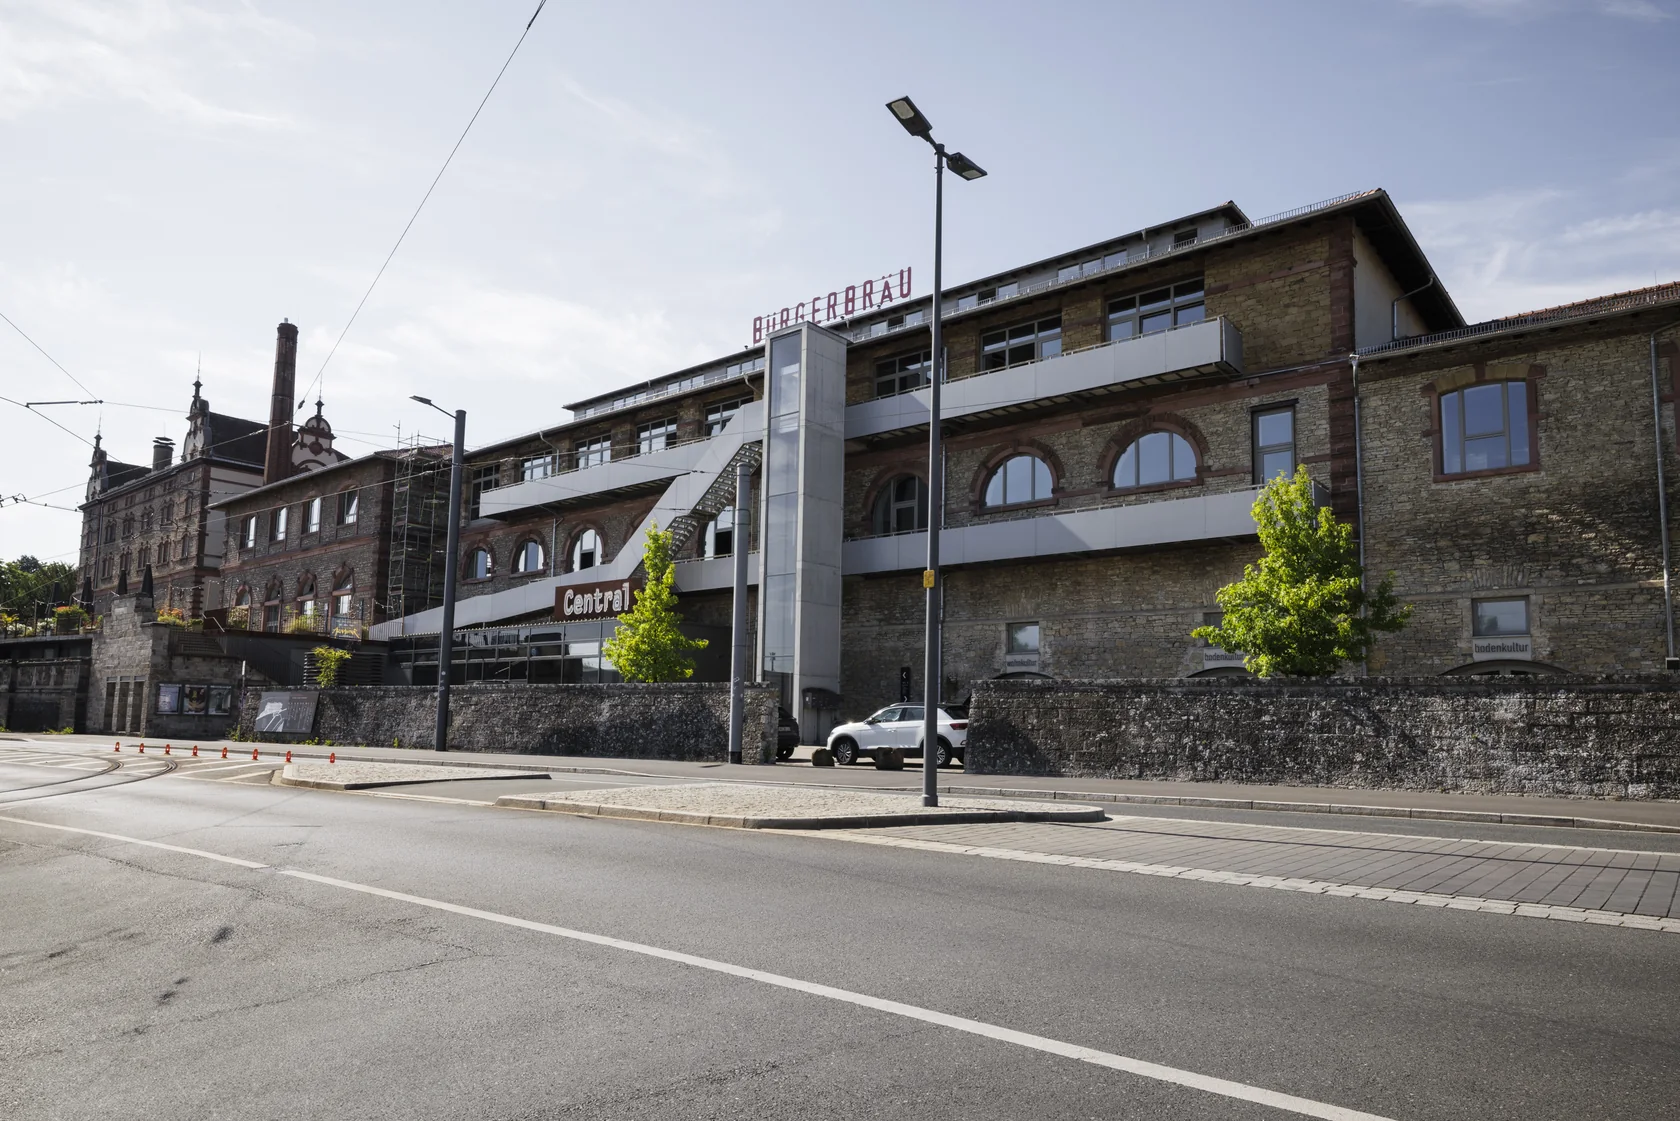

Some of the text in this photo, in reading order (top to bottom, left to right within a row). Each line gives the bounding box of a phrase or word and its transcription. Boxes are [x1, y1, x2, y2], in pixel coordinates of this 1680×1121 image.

[753, 266, 912, 344] BÜRGERBRÄU
[563, 582, 630, 616] Central
[1474, 642, 1529, 653] bodenkultur
